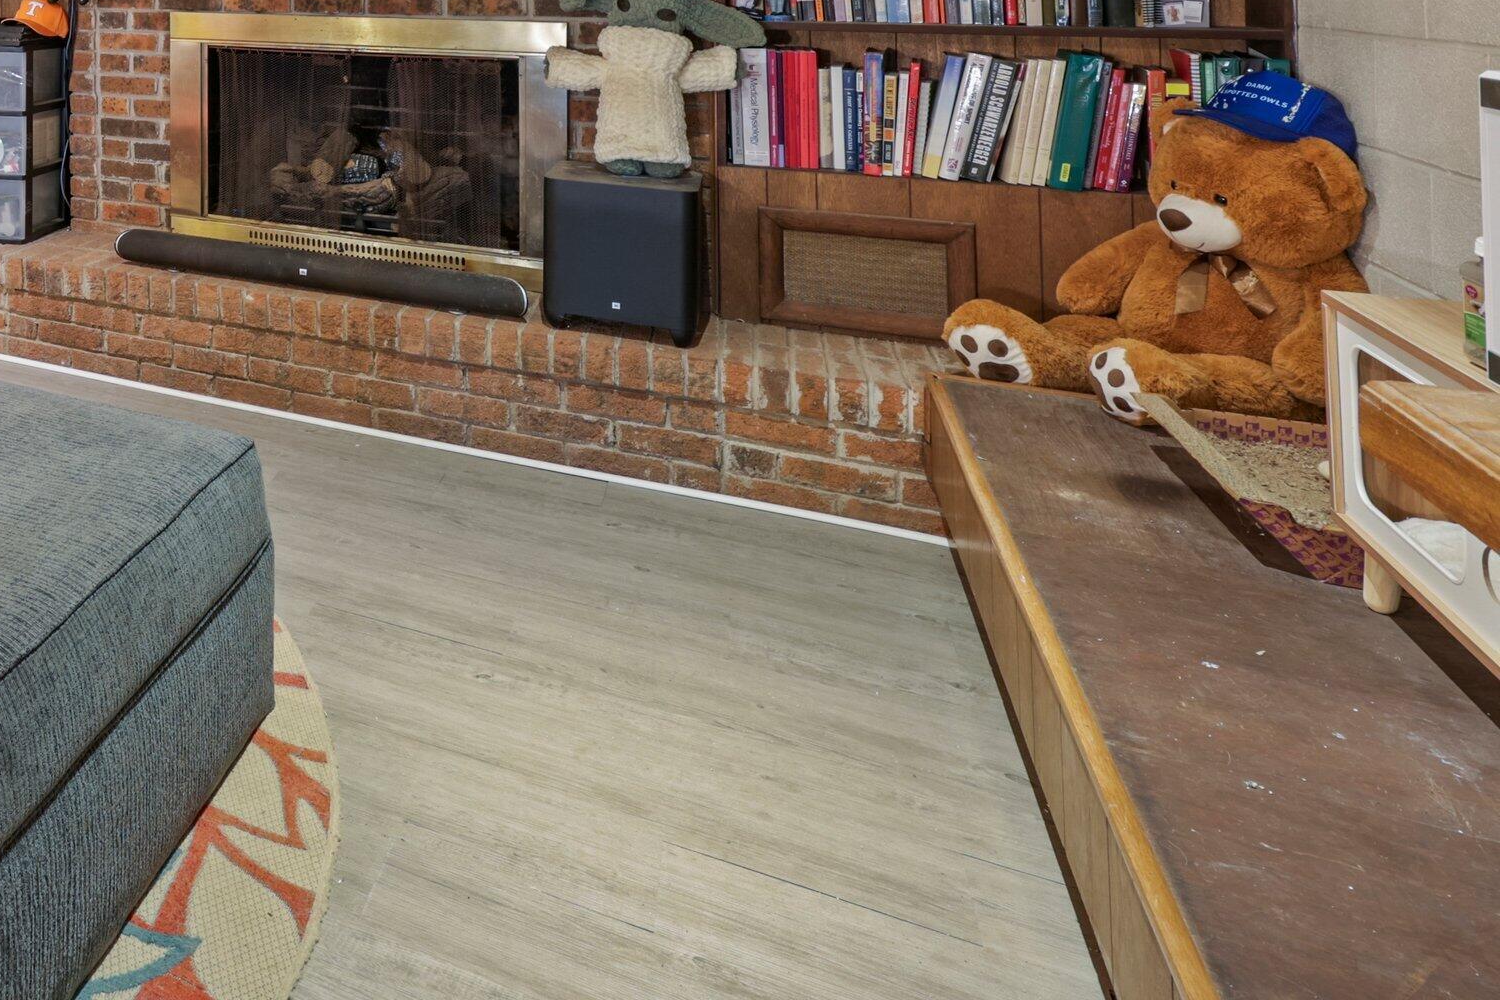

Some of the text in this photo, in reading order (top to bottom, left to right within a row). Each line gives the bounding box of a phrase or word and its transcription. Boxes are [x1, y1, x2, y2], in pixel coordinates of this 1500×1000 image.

[26, 1, 44, 17] T
[992, 63, 1014, 95] ARNOLD
[1245, 81, 1272, 92] DAMN
[750, 77, 759, 146] Medical Physiology
[1260, 95, 1289, 109] OWLS
[971, 95, 1005, 166] SCHWARZENEGGER
